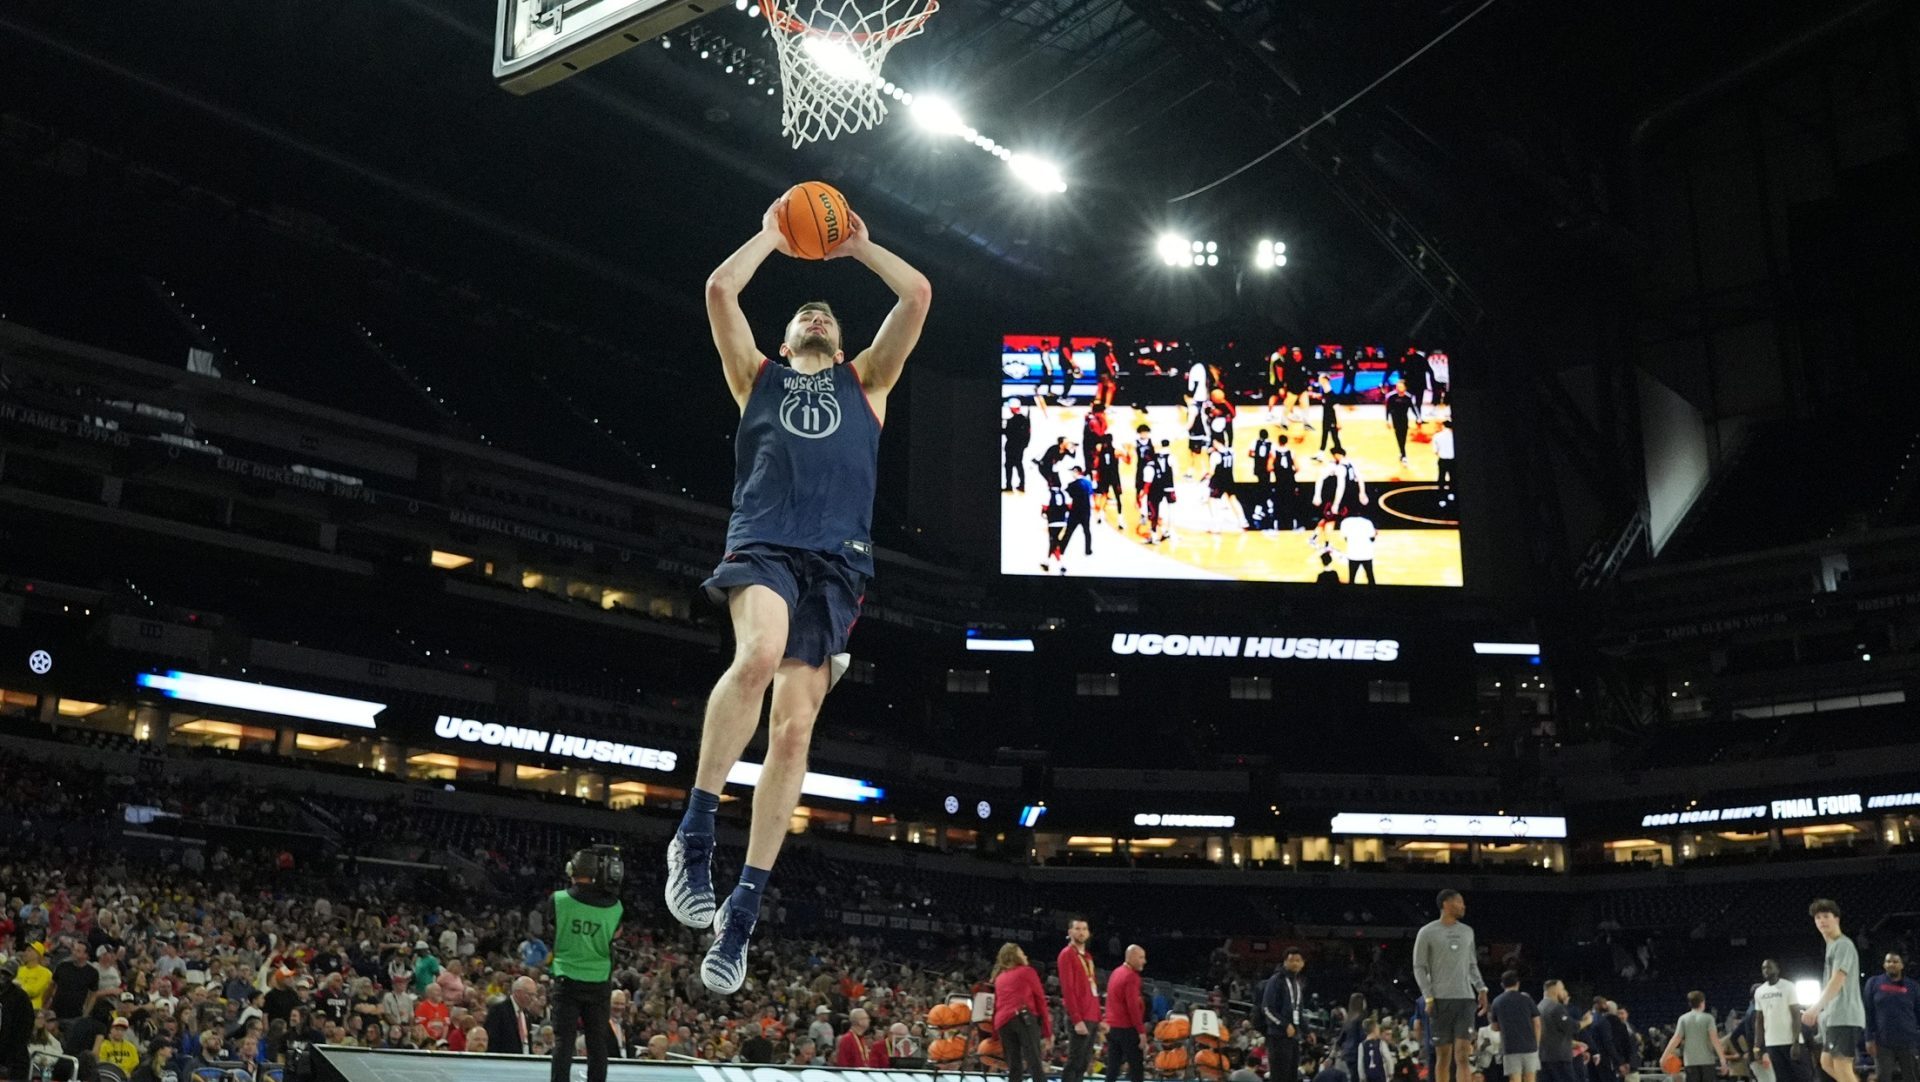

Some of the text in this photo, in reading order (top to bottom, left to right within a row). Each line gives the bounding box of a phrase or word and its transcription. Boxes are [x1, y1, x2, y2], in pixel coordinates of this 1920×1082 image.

[819, 193, 839, 244] Wilson
[784, 375, 835, 392] HUSKIES
[19, 410, 68, 433] JAMES
[801, 404, 820, 432] 11
[216, 455, 249, 475] ERIC
[252, 463, 326, 492] DICKERSON
[449, 509, 511, 534] MARSHALL
[1111, 633, 1400, 662] UCONN HUSKIES
[434, 715, 678, 773] UCONN HUSKIES
[1679, 809, 1720, 824] NCAA
[1771, 798, 1817, 819] FINAL
[1817, 794, 1863, 815] FOUR
[571, 919, 602, 938] 507
